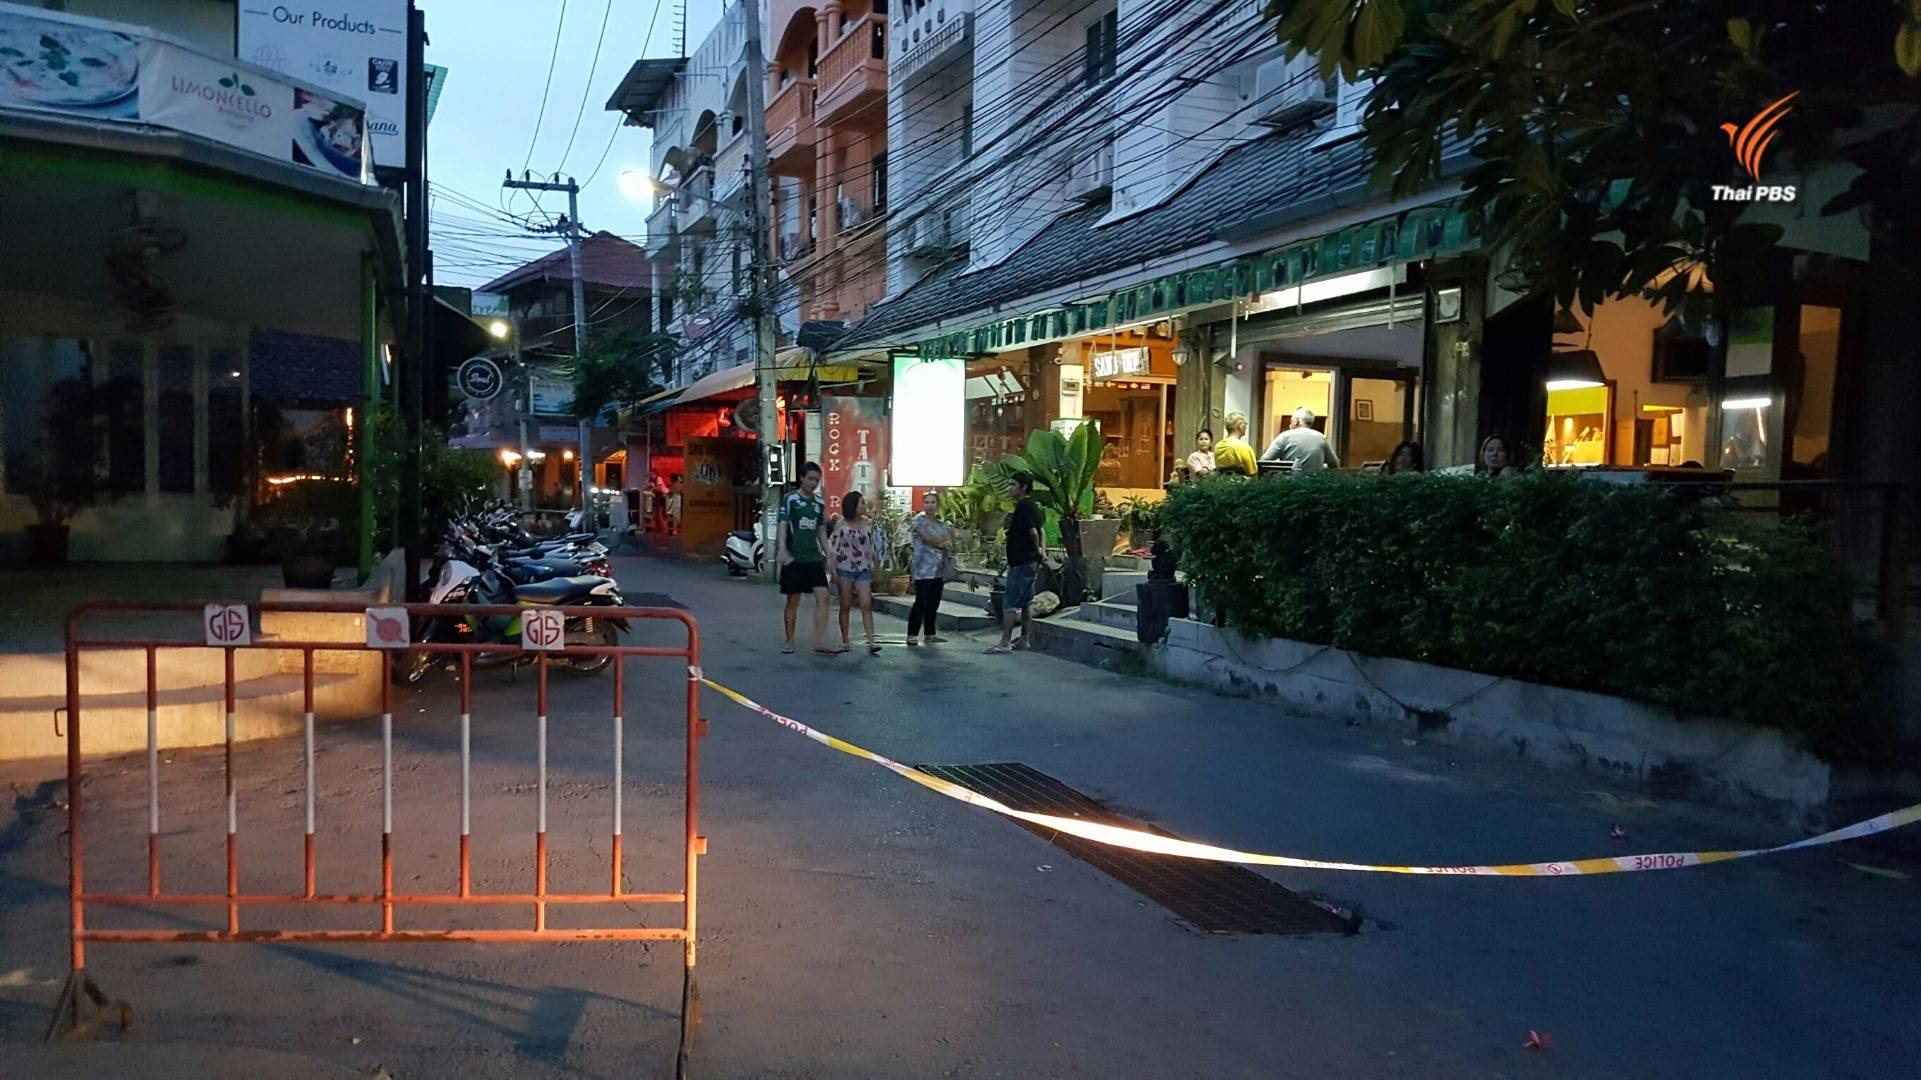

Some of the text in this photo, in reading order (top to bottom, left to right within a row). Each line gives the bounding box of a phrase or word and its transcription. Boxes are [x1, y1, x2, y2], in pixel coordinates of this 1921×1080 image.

[272, 6, 376, 35] Our Products
[171, 76, 272, 118] LIMONCELLO
[828, 412, 840, 472] ROCK
[1635, 854, 1685, 870] POLICE
